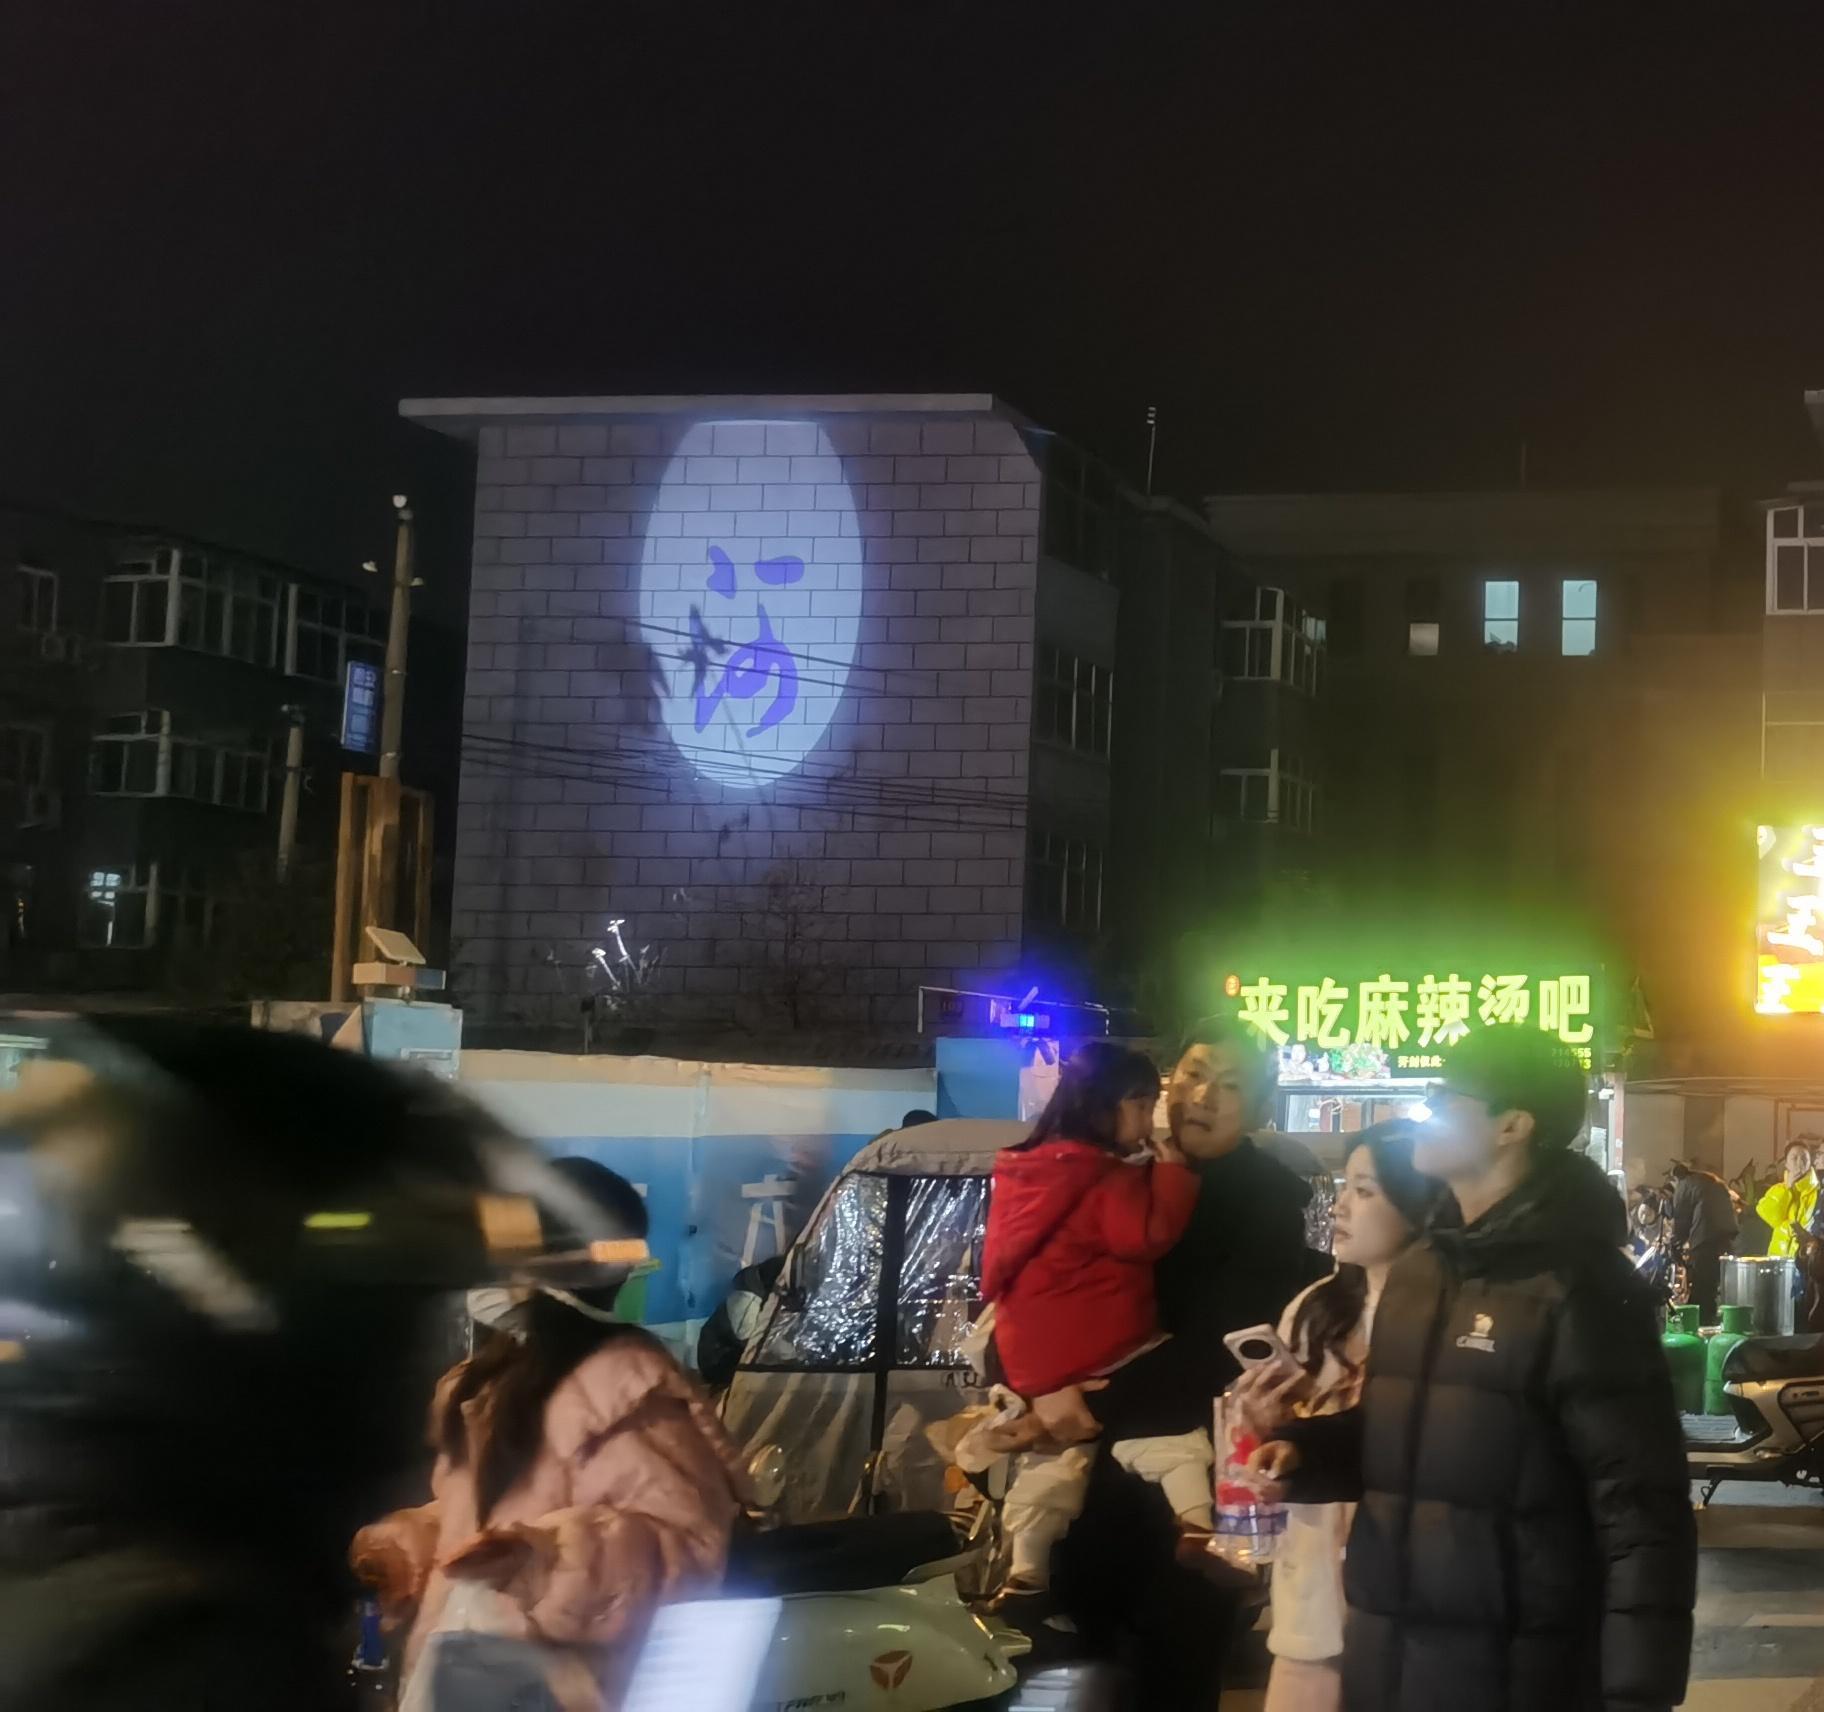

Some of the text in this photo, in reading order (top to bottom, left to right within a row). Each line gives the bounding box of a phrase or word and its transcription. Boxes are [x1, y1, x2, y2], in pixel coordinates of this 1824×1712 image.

[1238, 973, 1594, 1050] 来吃麻辣烫吧
